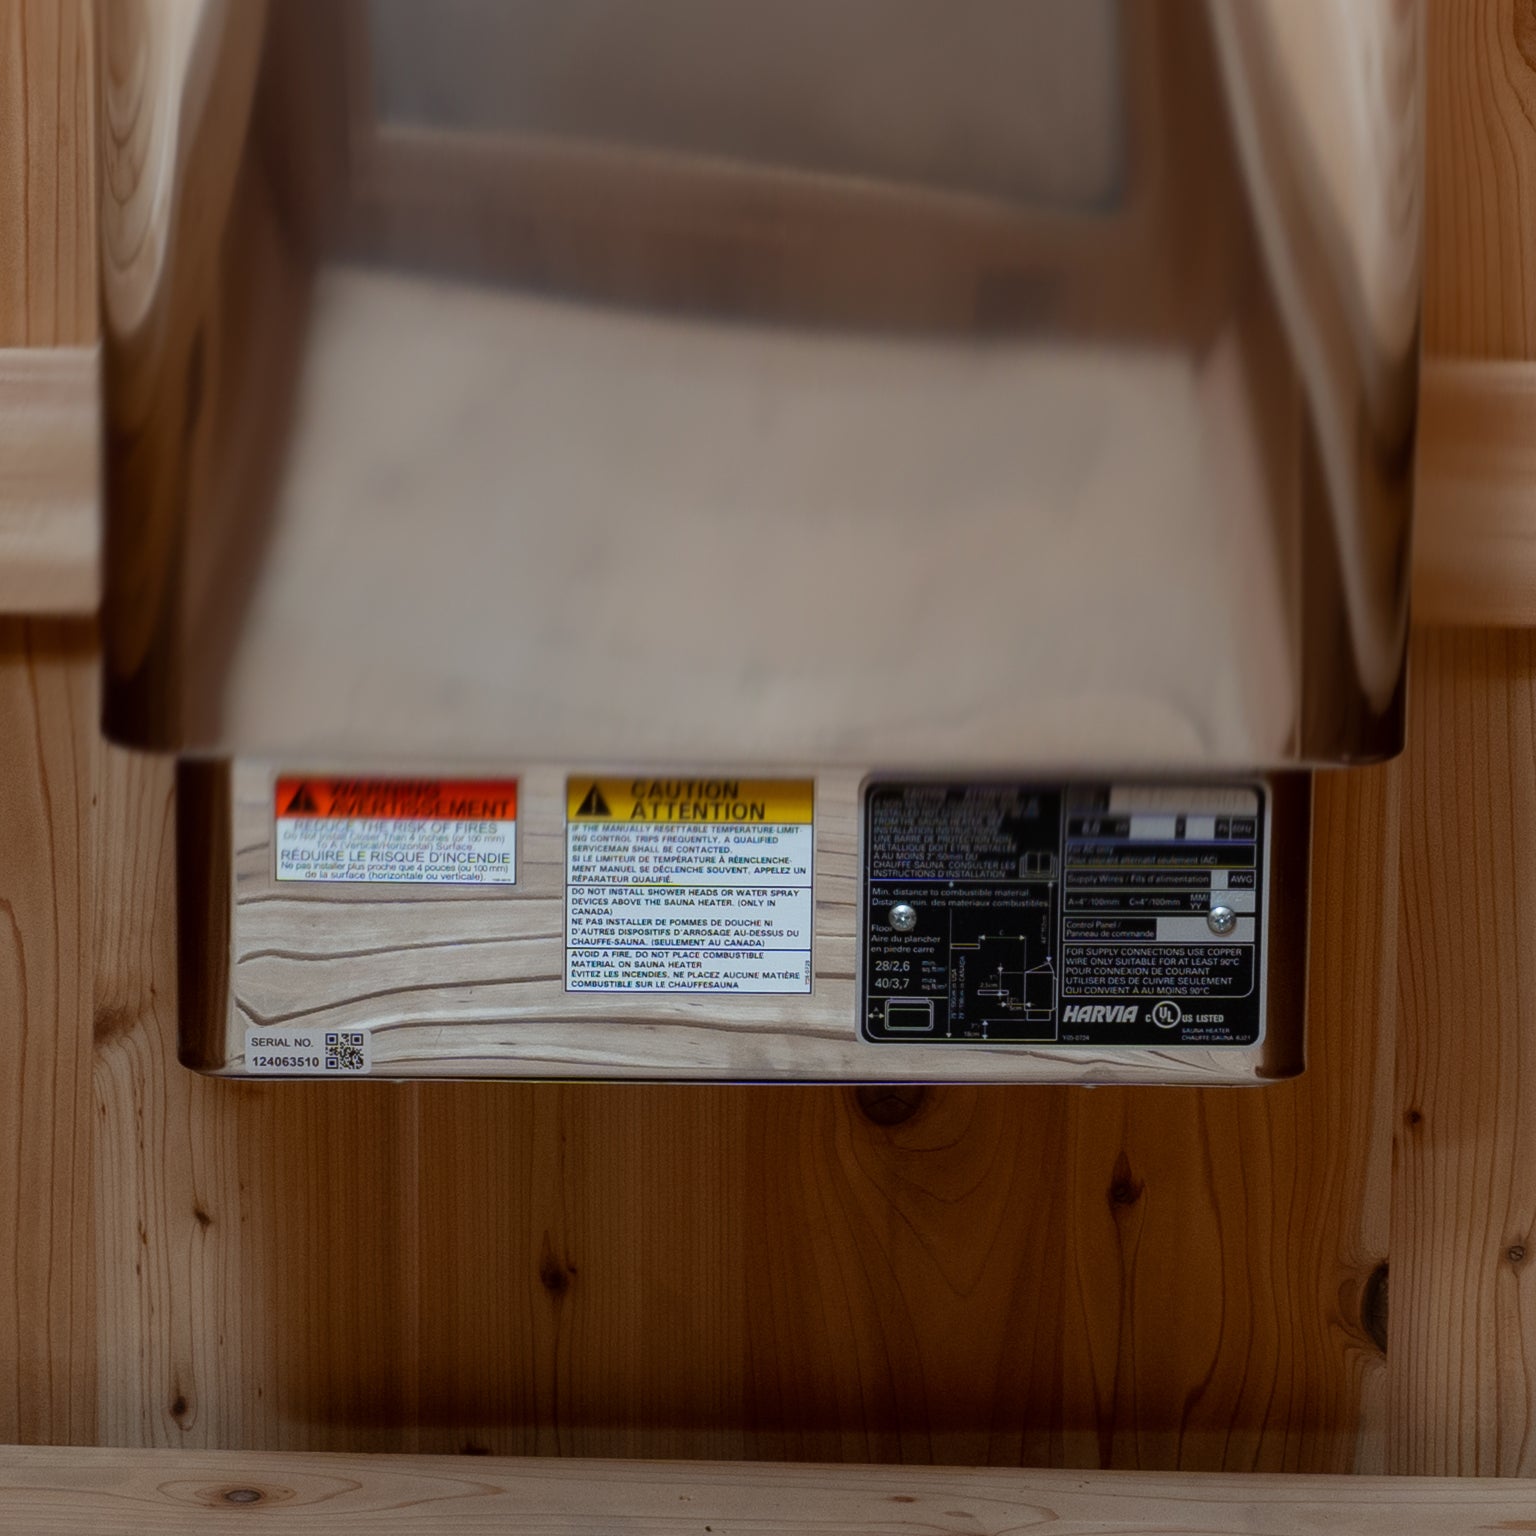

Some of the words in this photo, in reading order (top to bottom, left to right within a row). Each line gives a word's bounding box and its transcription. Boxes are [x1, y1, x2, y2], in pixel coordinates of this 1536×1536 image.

[631, 782, 739, 799] CAUTION
[632, 802, 765, 820] ATTENTION
[282, 850, 345, 862] RÉDUIRE
[349, 852, 367, 862] LE
[371, 852, 425, 862] RISQUE
[429, 852, 510, 863] D'INCENDIE
[651, 855, 715, 863] TEMPÉRATURE
[651, 865, 705, 873] DÉCLENCHE
[752, 866, 791, 874] APPELEZ
[331, 871, 365, 879] surface
[368, 872, 423, 881] (horizontale
[440, 872, 485, 881] verticale).
[572, 874, 629, 882] RÉPARATEUR
[738, 899, 764, 908] (ONLY
[767, 899, 775, 907] IN
[572, 908, 612, 916] CANADA)
[651, 939, 708, 948] (SEULEMENT
[710, 939, 722, 947] AU
[725, 939, 765, 948] CANADA)
[904, 936, 940, 944] plancher
[875, 961, 910, 972] 28/2,6
[572, 969, 601, 978] ÉVITEZ
[688, 971, 722, 979] PLACEZ
[762, 971, 800, 979] MATIÈRE
[875, 979, 909, 989] 40/3,7
[1063, 1006, 1139, 1022] HARVIA
[251, 1038, 291, 1047] SERIAL
[294, 1038, 313, 1047] NO.
[253, 1057, 319, 1067] 124063510
